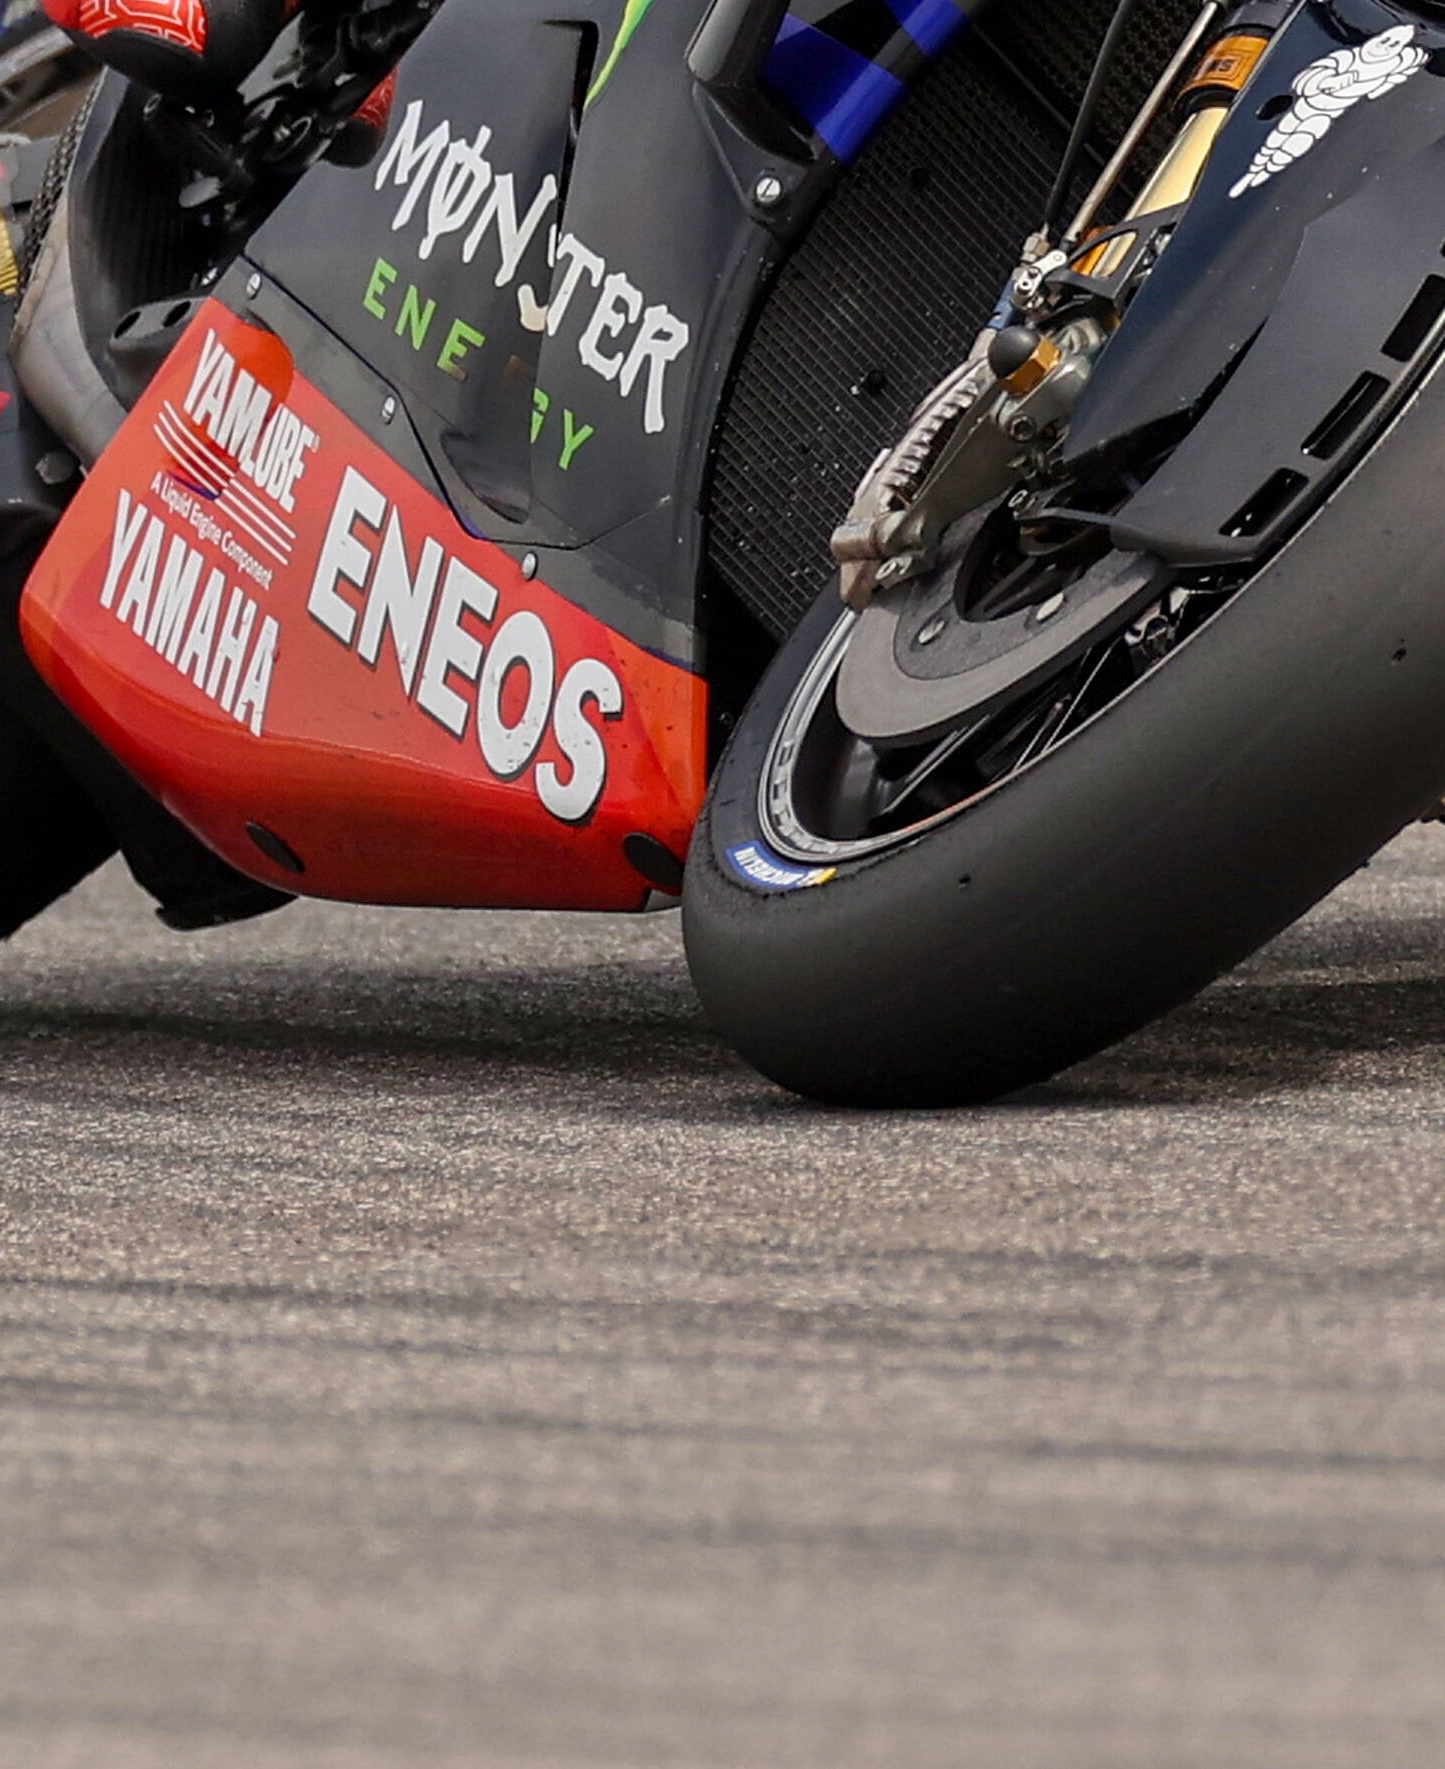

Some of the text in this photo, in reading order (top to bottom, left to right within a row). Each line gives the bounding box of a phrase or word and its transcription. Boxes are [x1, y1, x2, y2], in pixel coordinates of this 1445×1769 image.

[99, 488, 282, 736] YAMAHA
[150, 472, 274, 591] A Liquid Engine Component
[307, 465, 624, 822] ENEOS
